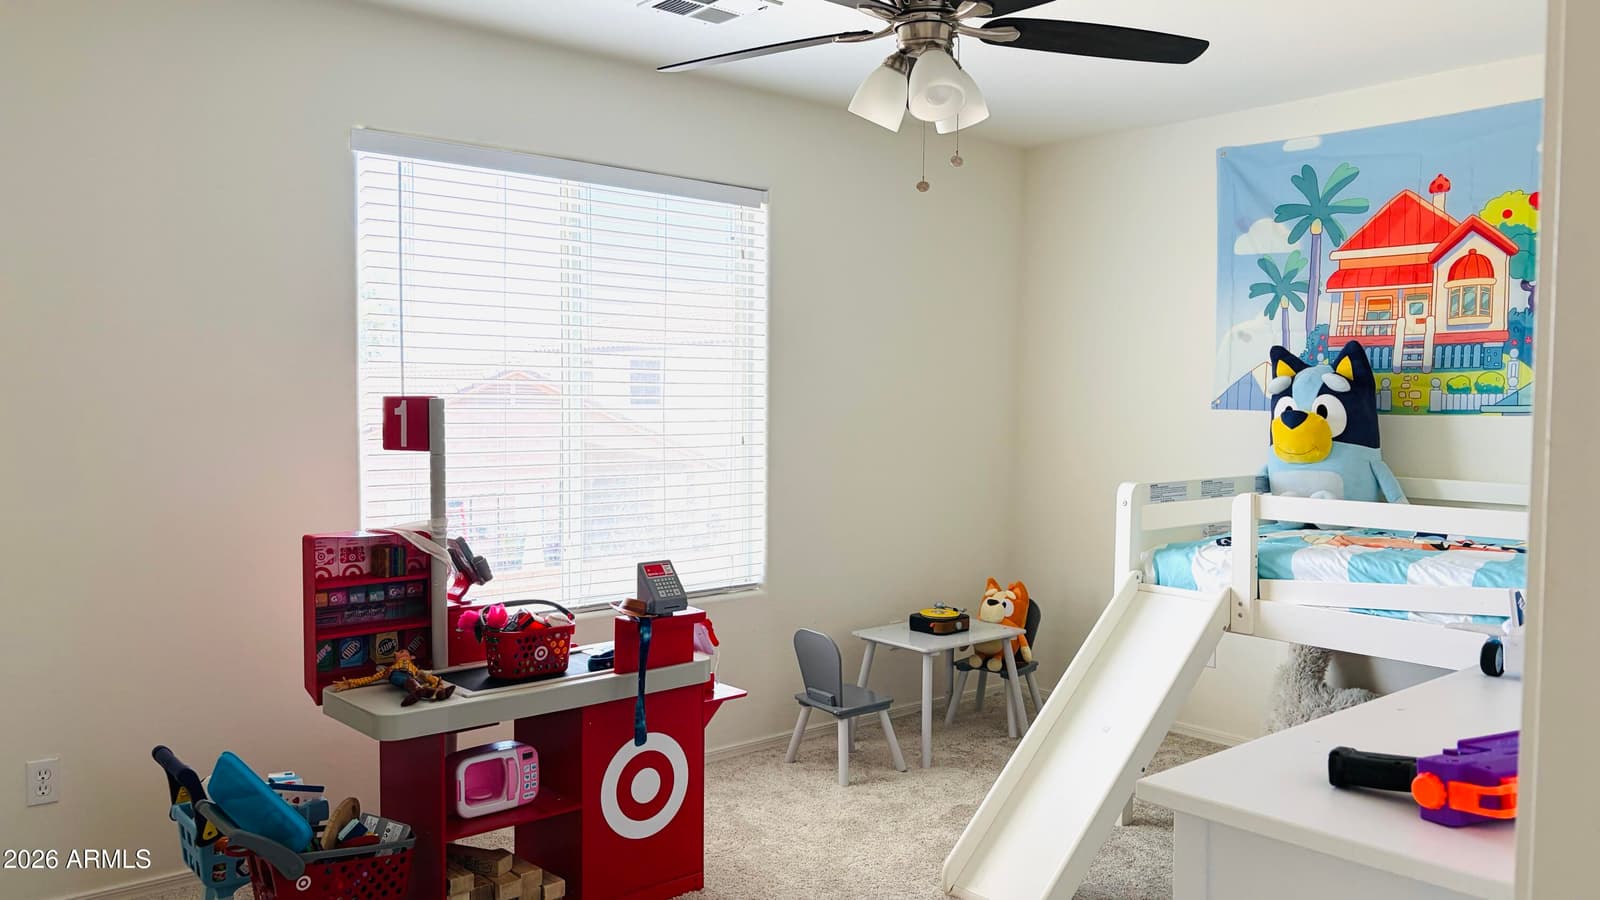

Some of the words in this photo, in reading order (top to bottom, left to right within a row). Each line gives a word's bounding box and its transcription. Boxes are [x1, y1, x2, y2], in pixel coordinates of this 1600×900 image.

[394, 399, 407, 448] 1
[316, 643, 333, 664] HIPS
[341, 639, 362, 660] CHIPS
[377, 639, 398, 656] CHIPS
